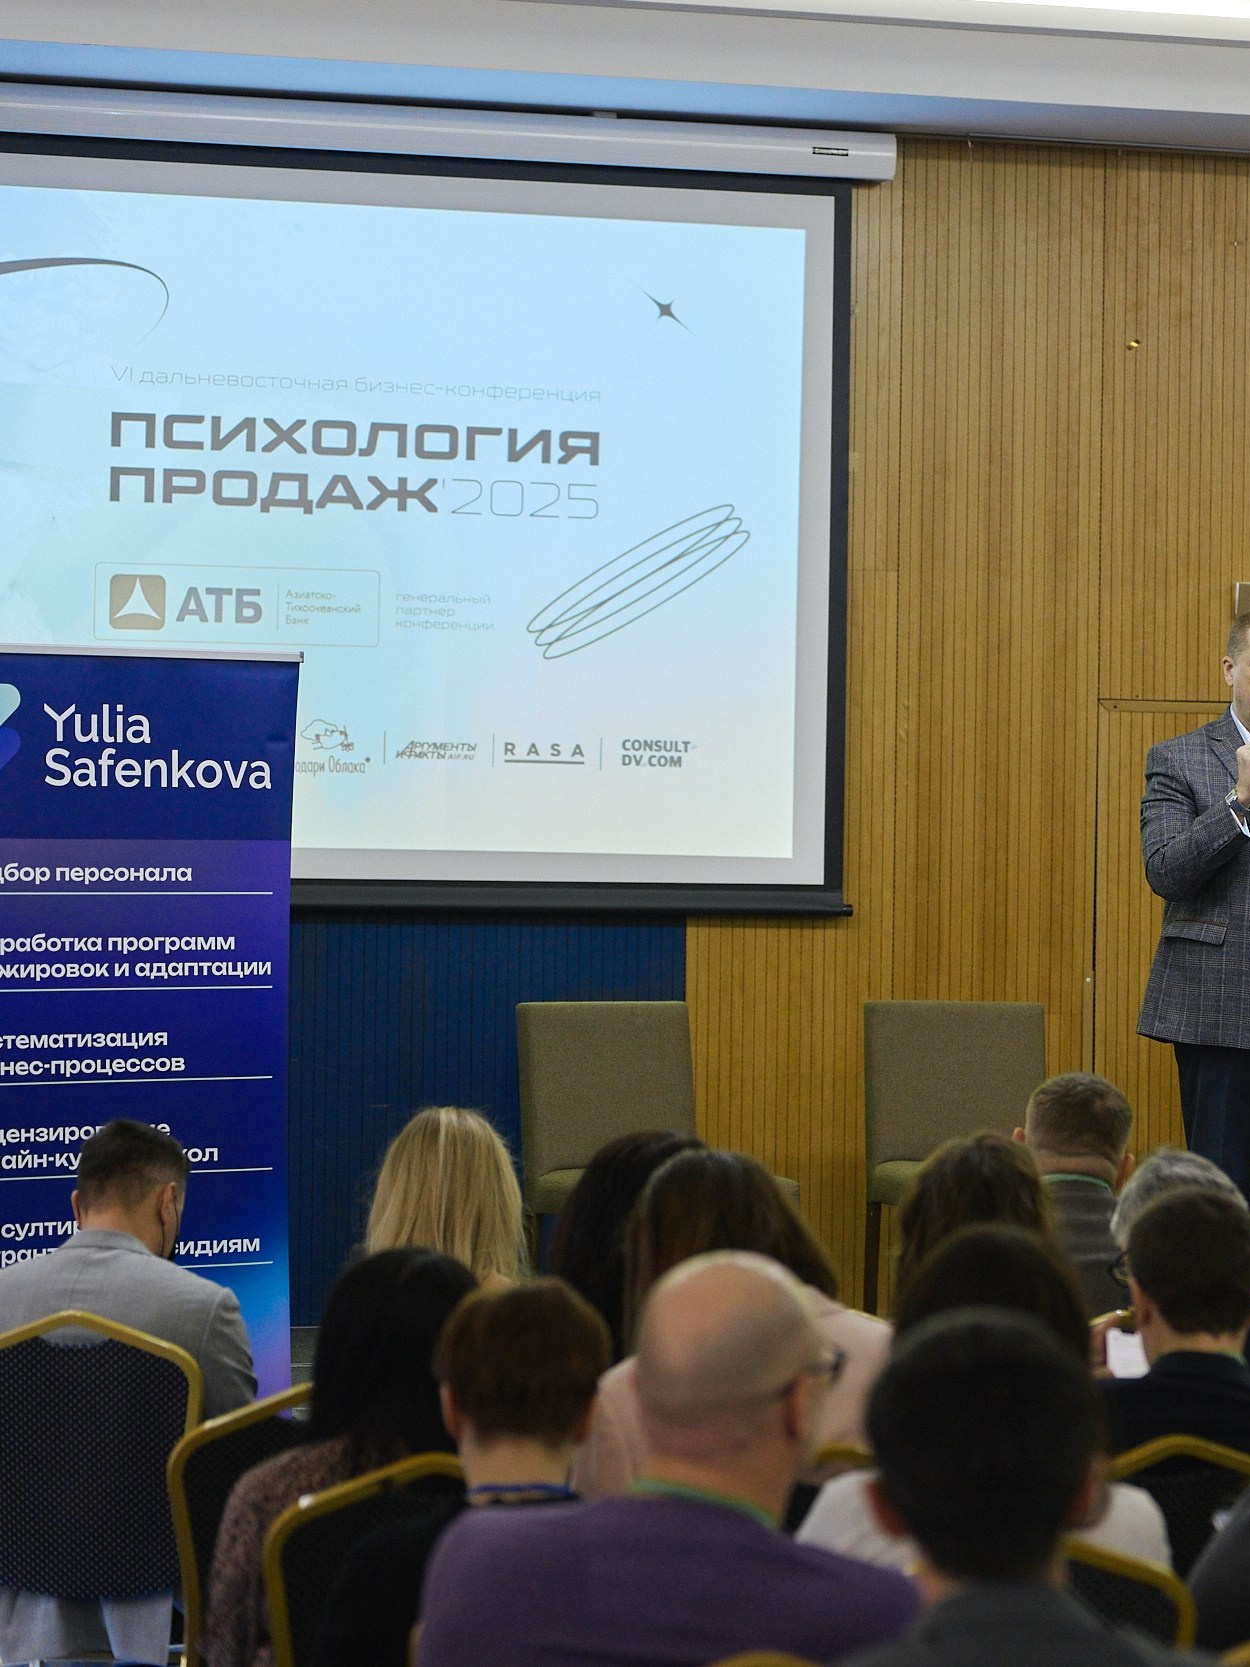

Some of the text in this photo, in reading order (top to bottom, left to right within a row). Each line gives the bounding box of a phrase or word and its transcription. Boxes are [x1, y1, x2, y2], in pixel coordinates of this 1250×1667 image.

[111, 366, 601, 402] VI дальневосточная бизнес-конференция
[111, 411, 600, 466] ПСИХОЛОГИЯ
[176, 587, 263, 624] АТБ
[286, 602, 362, 614] Тихоокеанский
[396, 592, 492, 605] генеральный
[285, 615, 309, 625] Банк
[396, 606, 456, 618] партнер
[396, 620, 494, 632] конференции
[43, 703, 151, 743] Yulia
[44, 748, 272, 790] Safenkova
[295, 759, 325, 777] одари
[55, 867, 193, 885] персонала
[0, 933, 236, 956] работка программ
[114, 962, 130, 977] и
[135, 961, 272, 979] адаптации
[0, 1031, 169, 1050] тематизация
[0, 1057, 186, 1078] нес-процессов
[1, 1149, 83, 1171] айн-ку
[174, 1238, 261, 1258] идиям
